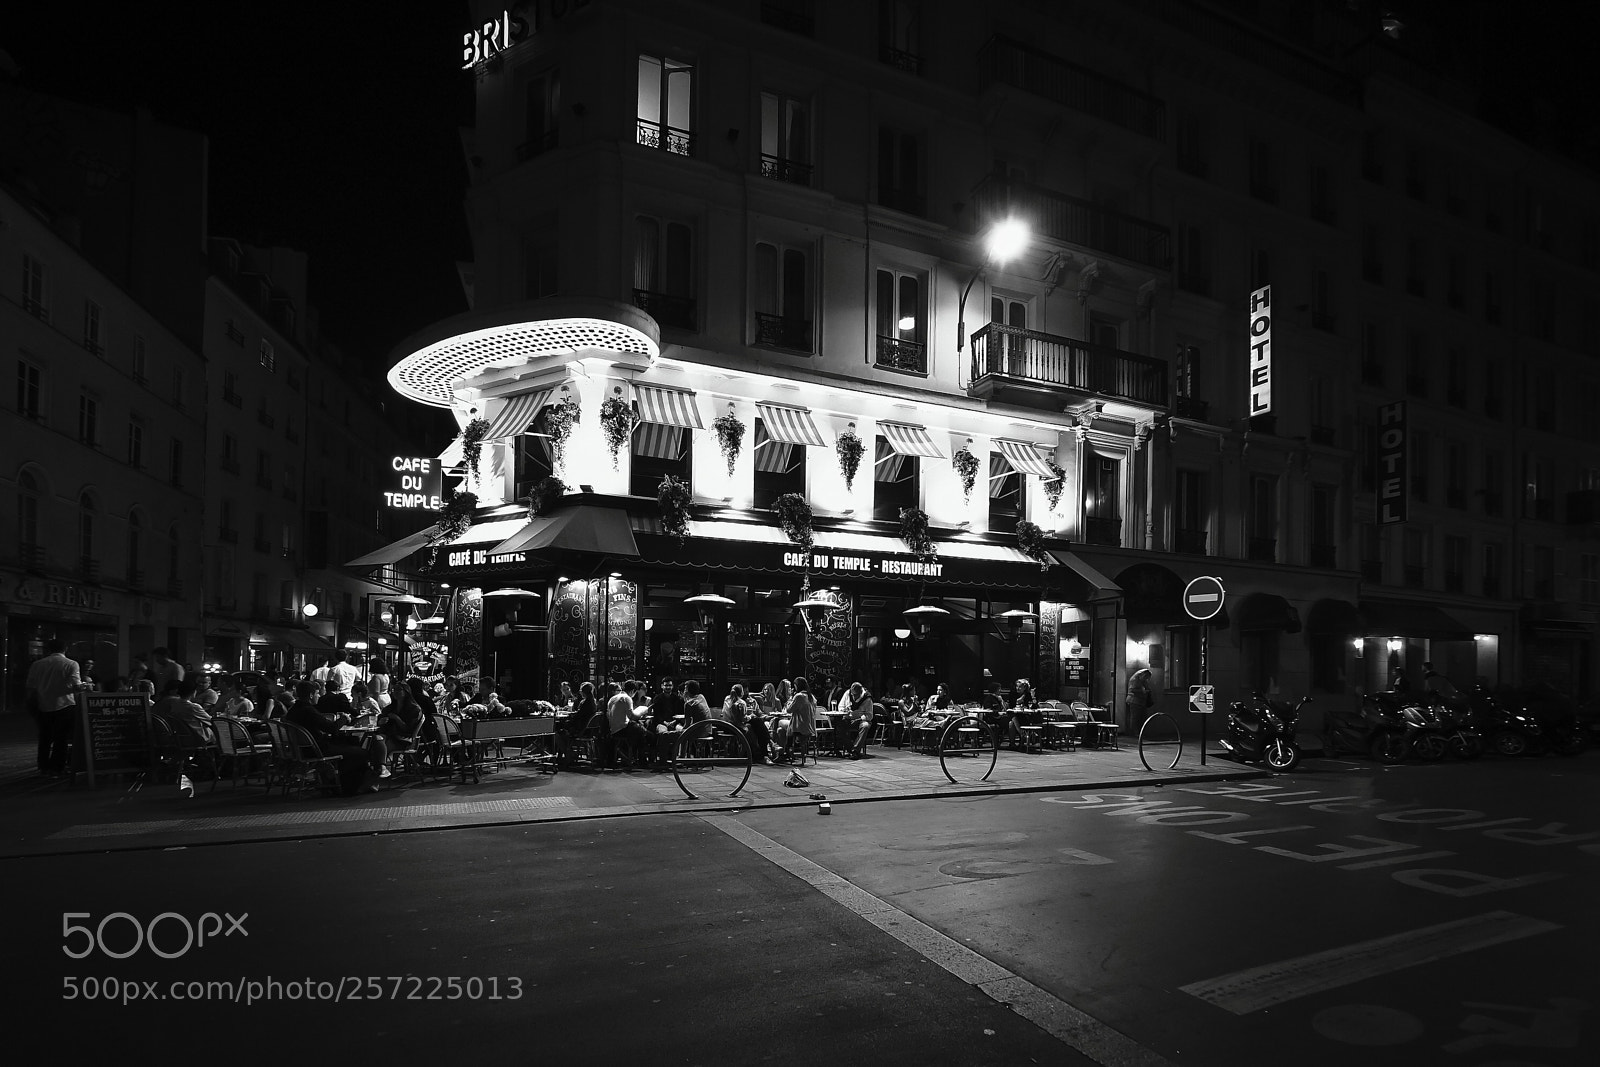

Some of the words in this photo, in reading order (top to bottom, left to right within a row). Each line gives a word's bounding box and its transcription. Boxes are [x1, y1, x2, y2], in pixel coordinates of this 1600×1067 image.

[1251, 288, 1270, 412] HOTEL
[392, 456, 430, 473] CAFE
[1381, 402, 1402, 523] HOTEL
[402, 475, 422, 490] DU
[383, 492, 440, 510] TEMPLE
[449, 549, 471, 567] CAFÉ
[473, 550, 487, 565] DU
[813, 554, 828, 568] DU
[832, 556, 870, 571] TEMPLE
[881, 560, 943, 577] RESTAURANT
[88, 698, 116, 707] HAPPY
[118, 698, 142, 707] HOUR
